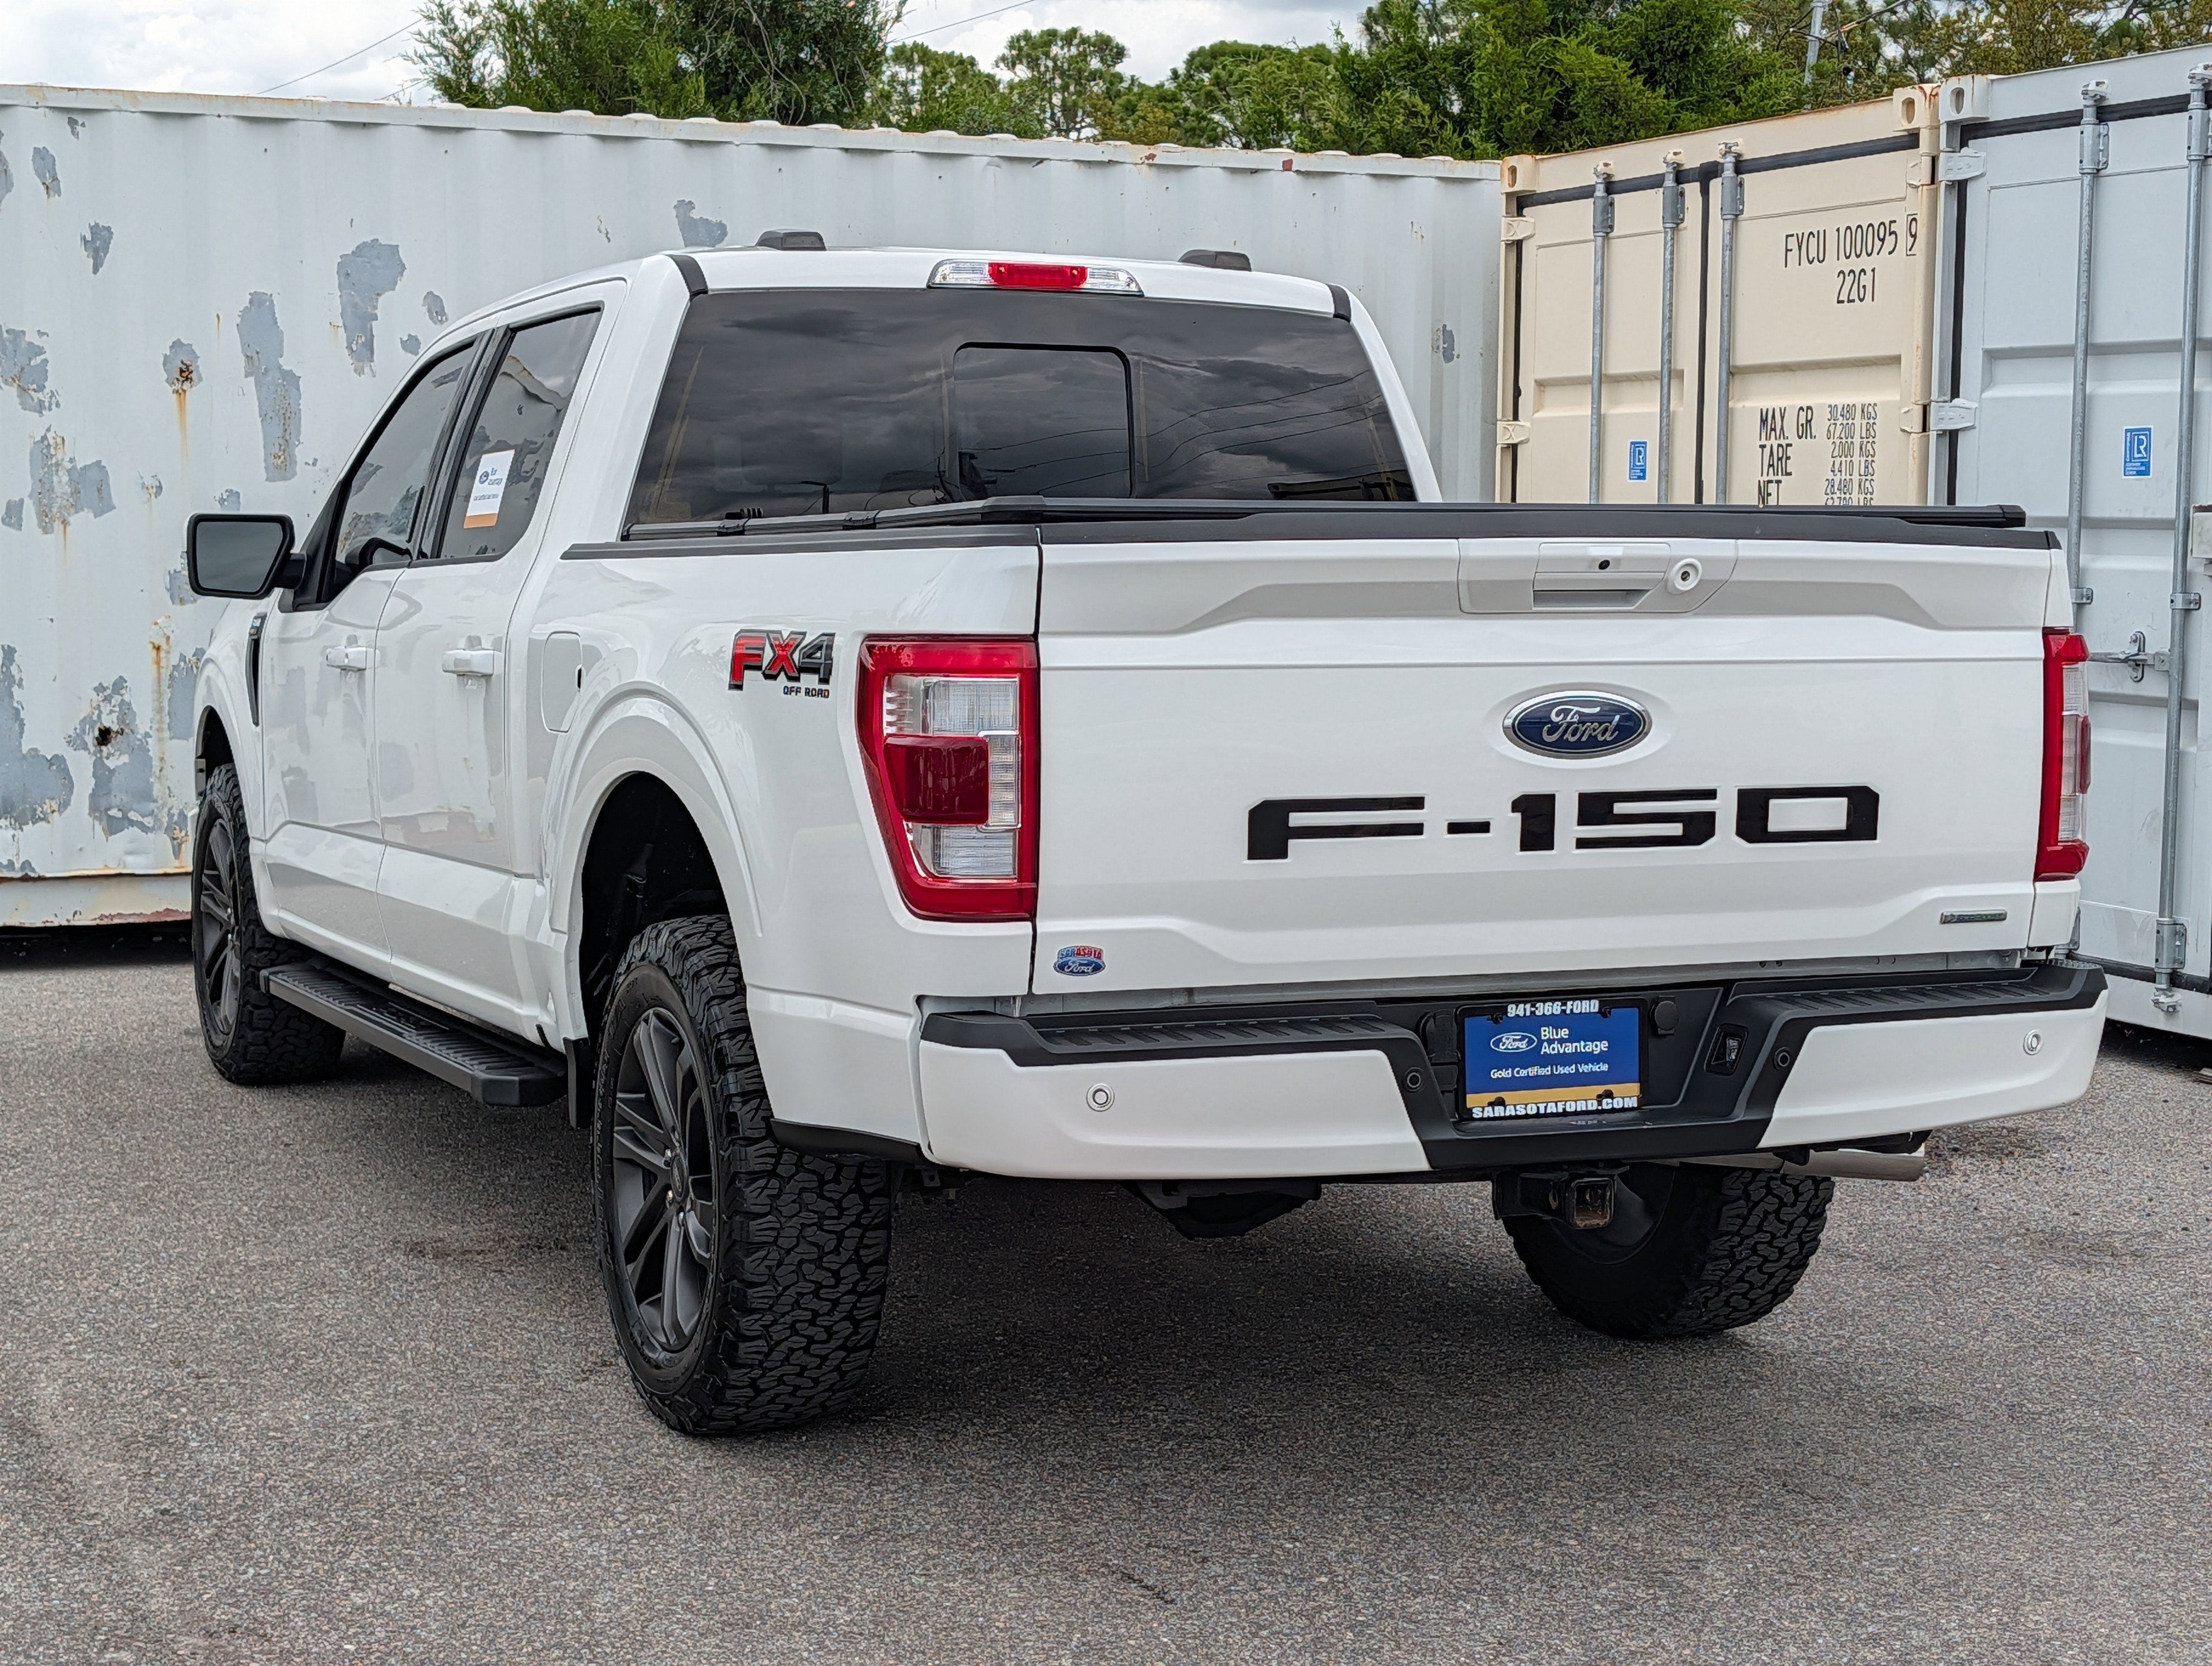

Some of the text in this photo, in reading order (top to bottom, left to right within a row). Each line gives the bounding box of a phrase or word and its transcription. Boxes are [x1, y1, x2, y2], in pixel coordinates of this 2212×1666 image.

[1785, 217, 1918, 268] FYCU 100095 9
[1837, 267, 1876, 304] 22G1
[1759, 407, 1789, 441] MAX.
[1796, 406, 1816, 439] GR.
[1860, 402, 1877, 420] KGS
[1860, 421, 1876, 439] LBS
[1759, 443, 1792, 477] TARE
[1859, 440, 1876, 458] KGS
[1859, 459, 1875, 477] LBS
[1857, 478, 1875, 495] KGS
[728, 629, 836, 691] FX4
[783, 685, 829, 699] OFF ROAD
[1542, 706, 1619, 742] Ford
[1247, 786, 1880, 861] F-150
[1064, 960, 1095, 972] Ford
[1499, 1035, 1528, 1049] Ford
[1541, 1027, 1569, 1040] Blue
[1540, 1040, 1608, 1054] Advantage
[1490, 1062, 1609, 1079] Gold Certified Used Vehicle
[1472, 1097, 1637, 1118] SARASOTAFORD.COM
